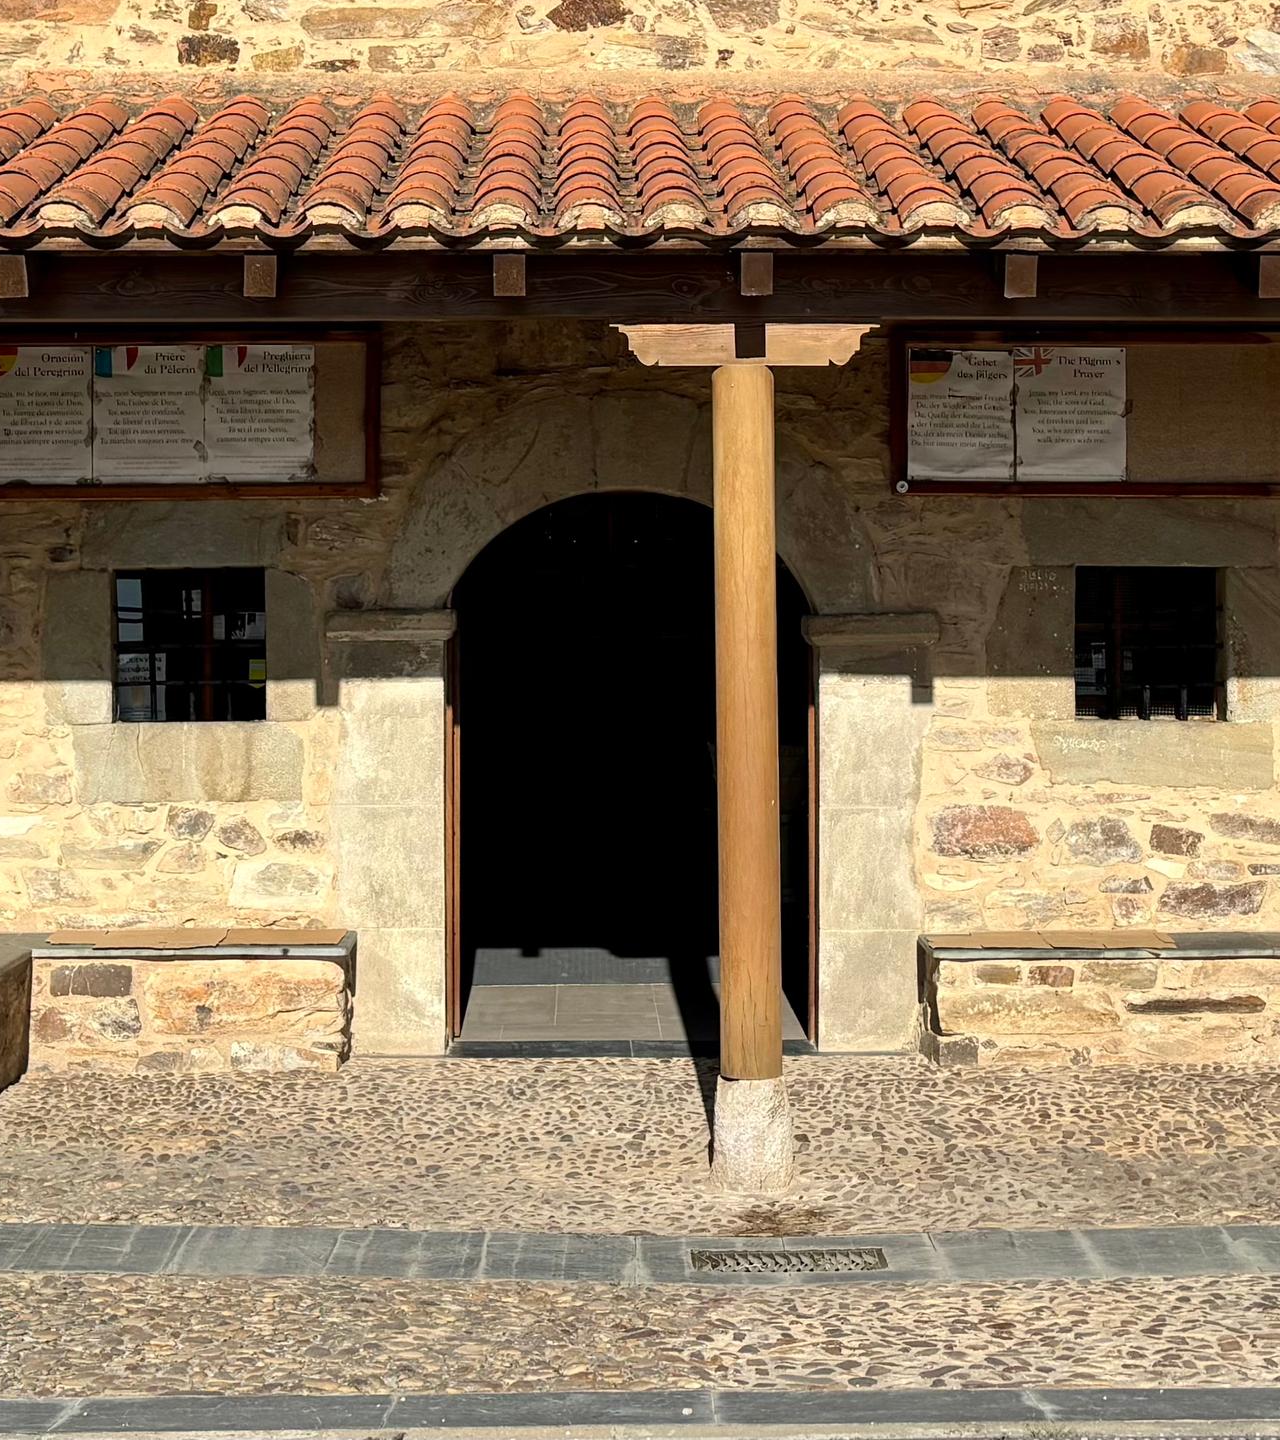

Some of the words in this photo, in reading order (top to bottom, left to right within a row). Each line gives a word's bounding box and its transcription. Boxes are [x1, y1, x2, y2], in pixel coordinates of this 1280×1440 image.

[263, 351, 311, 362] Preghiera
[1057, 356, 1076, 365] The
[968, 357, 996, 367] Gebet
[14, 367, 30, 377] del
[33, 367, 85, 379] Peregrino
[144, 364, 157, 374] du
[244, 363, 258, 373] del
[262, 363, 312, 375] Pellegrino
[1073, 368, 1105, 379] Prayer
[957, 370, 973, 379] des
